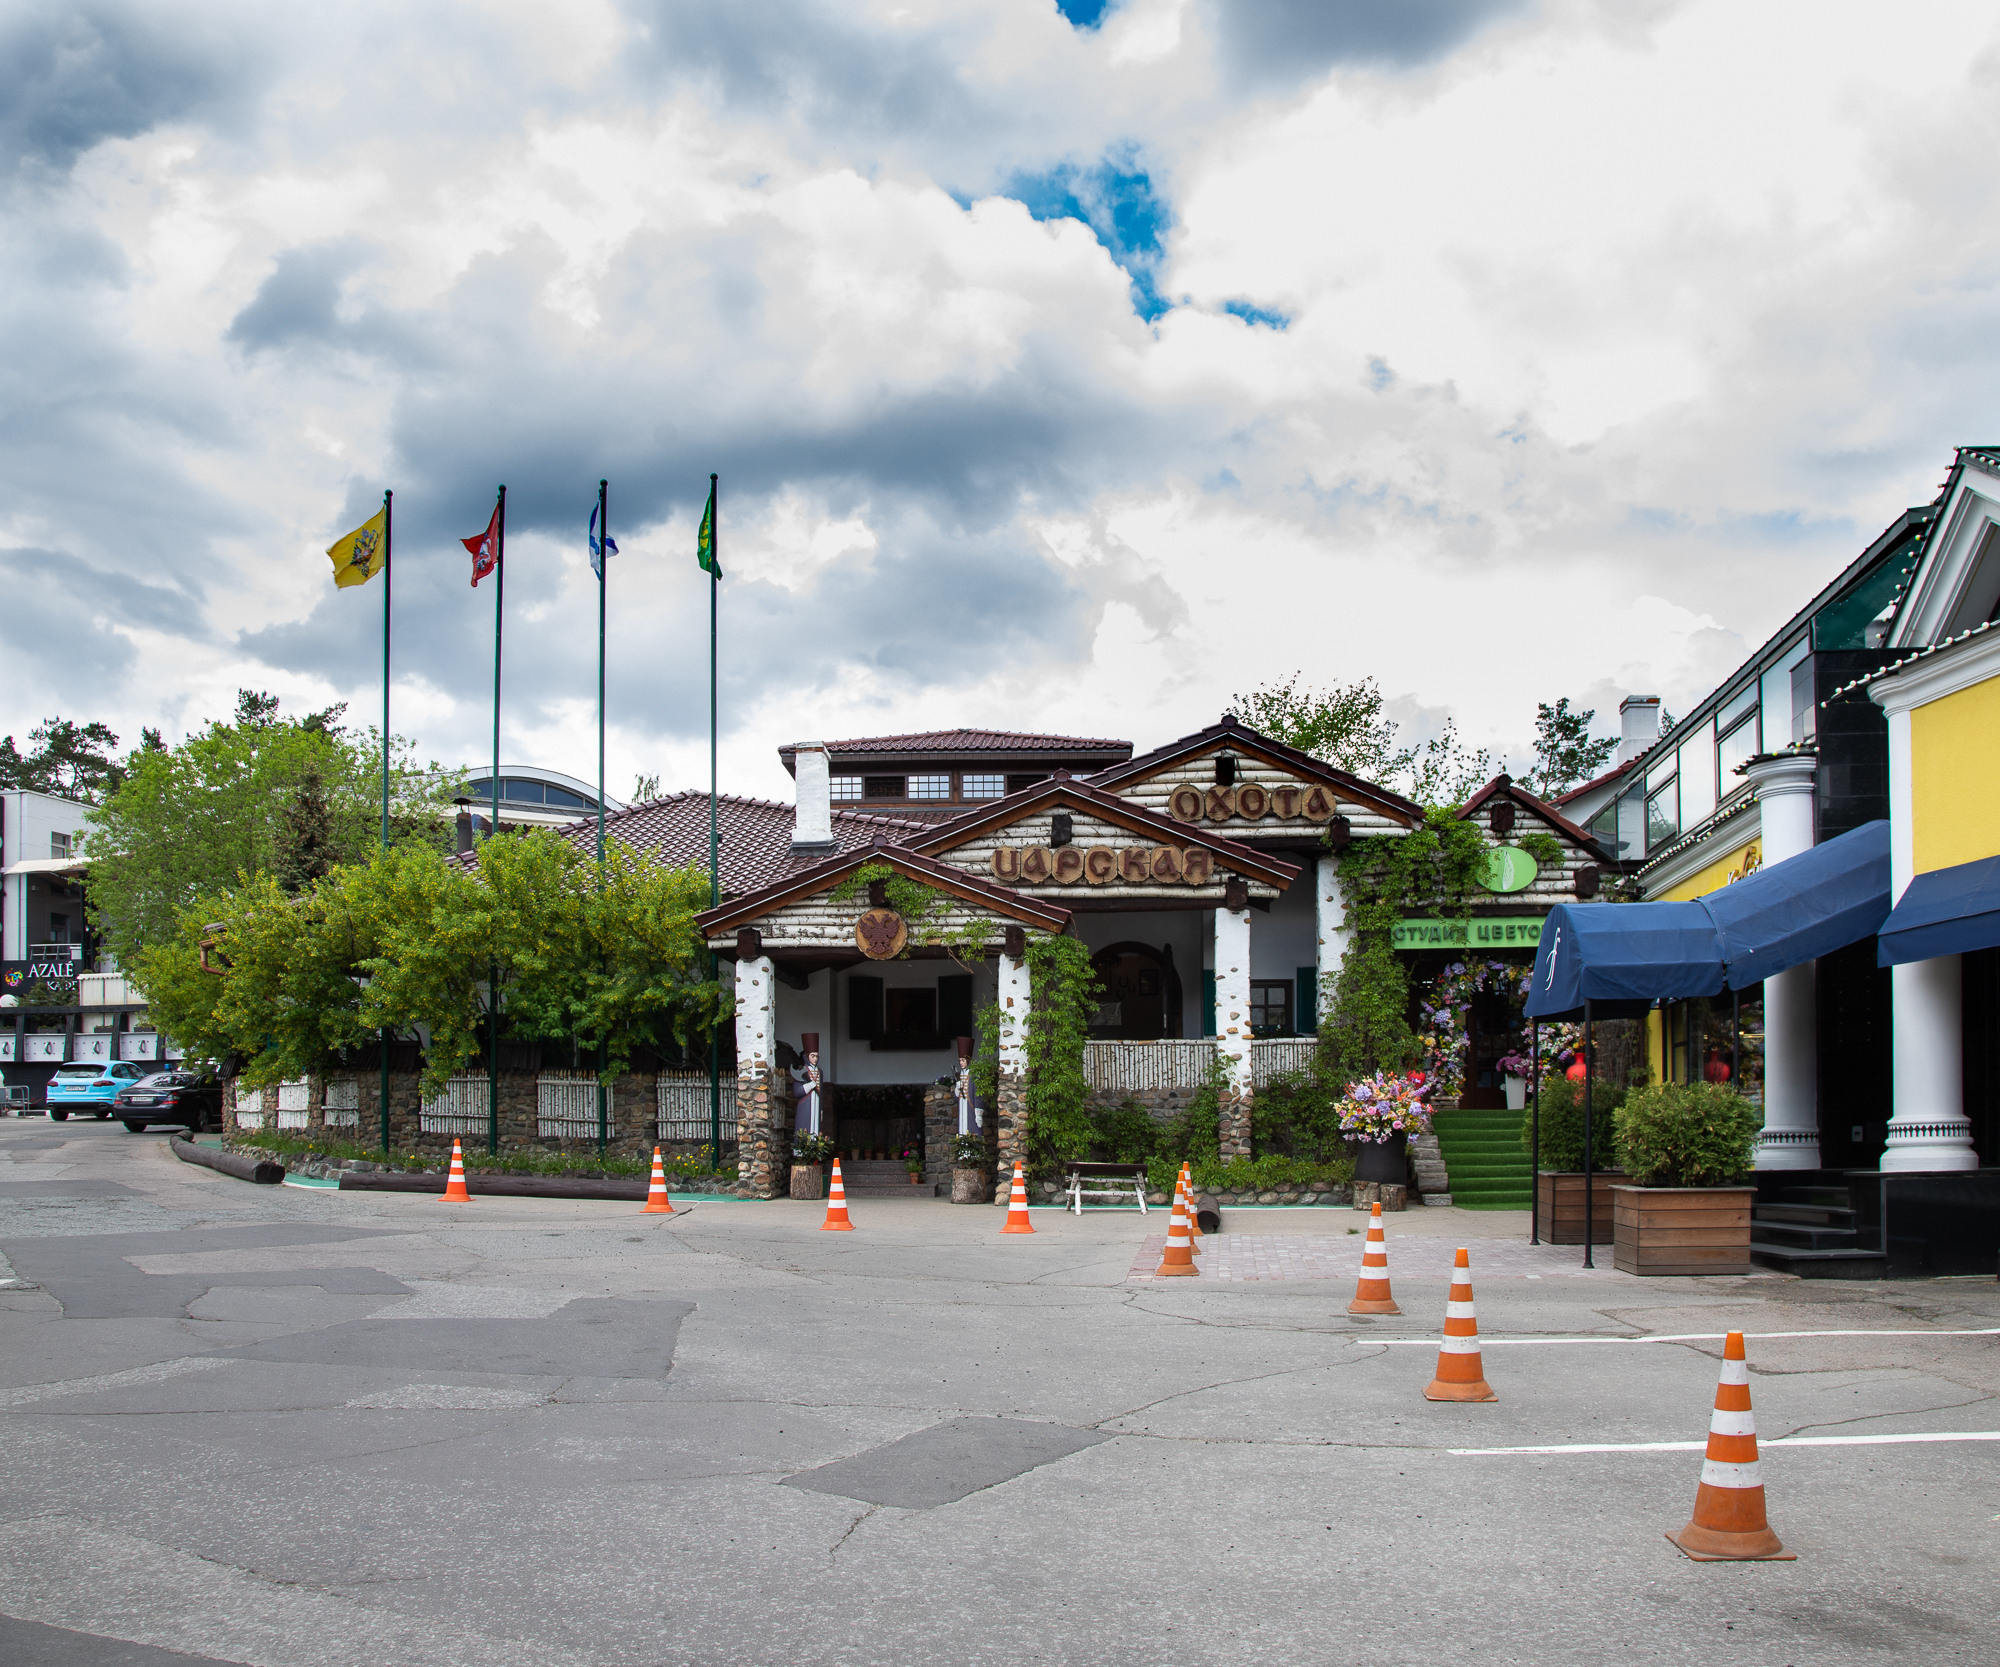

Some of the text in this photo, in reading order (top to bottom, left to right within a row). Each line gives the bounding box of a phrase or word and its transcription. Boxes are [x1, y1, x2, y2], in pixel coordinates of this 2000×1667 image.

[1175, 786, 1332, 818] ОХОТА
[994, 847, 1209, 877] ЦАРСКАЯ
[1477, 923, 1544, 942] ЦВЕТО
[27, 960, 74, 978] AZALÉ
